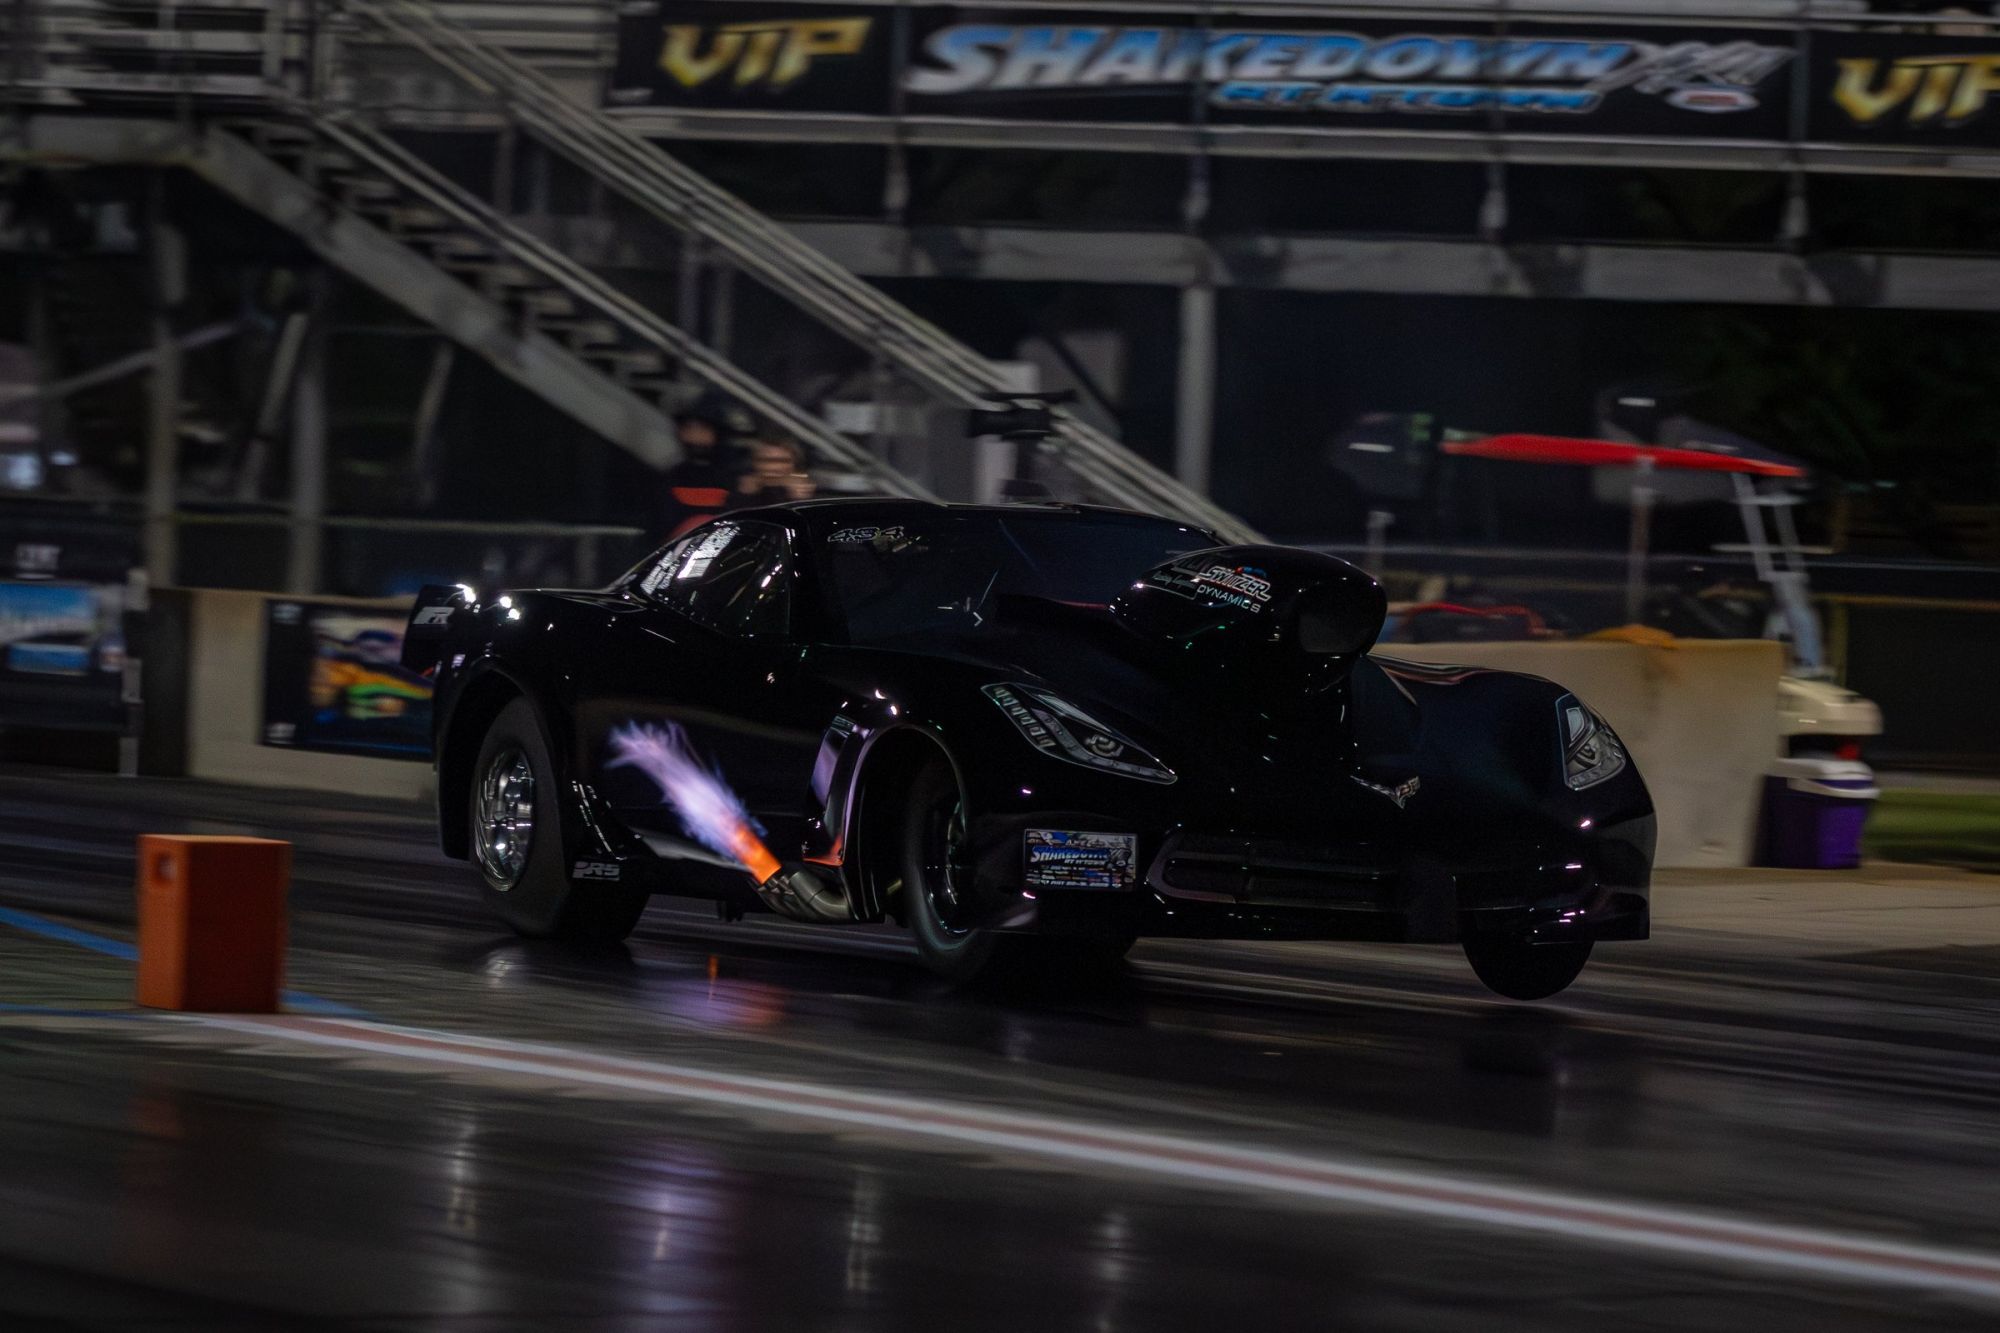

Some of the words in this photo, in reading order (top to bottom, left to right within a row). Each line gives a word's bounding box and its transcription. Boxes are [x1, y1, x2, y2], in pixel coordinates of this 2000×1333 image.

[905, 25, 1628, 94] SHAKEDOWN
[1197, 584, 1262, 614] DYNAMICS
[1199, 565, 1272, 602] SWITZER
